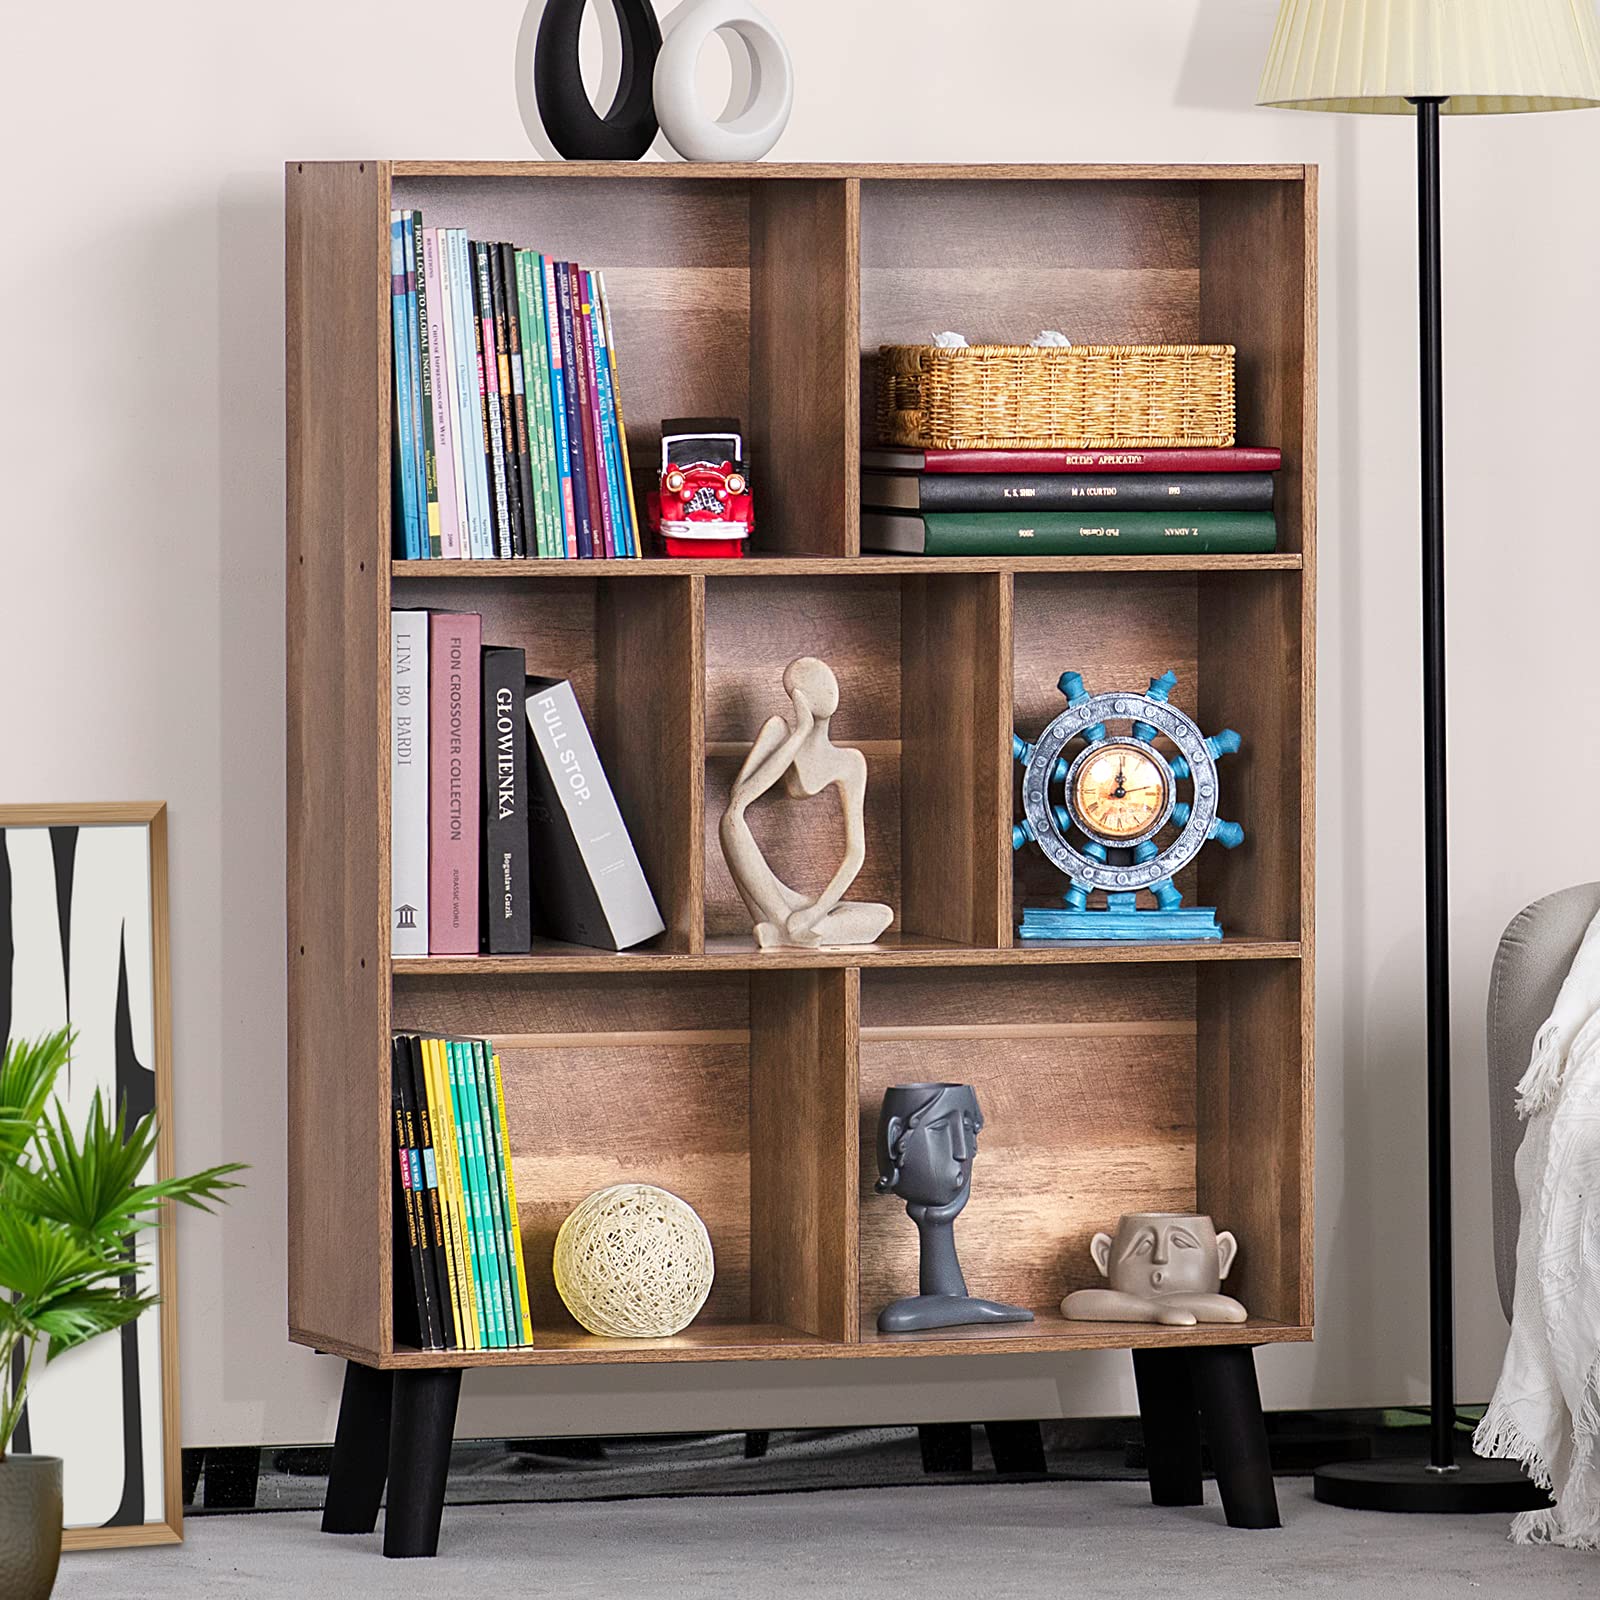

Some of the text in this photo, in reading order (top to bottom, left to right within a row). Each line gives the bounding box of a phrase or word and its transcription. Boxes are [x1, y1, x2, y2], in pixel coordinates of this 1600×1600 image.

[414, 225, 431, 396] FROM LOCAL TO GLOBAL ENGLISH
[526, 284, 535, 316] Englishes
[535, 287, 544, 319] Englishes
[545, 264, 560, 359] ENGLISH WORLD-WIDE
[474, 316, 479, 324] EA
[497, 316, 502, 324] EA
[511, 316, 515, 324] EA
[575, 316, 583, 342] Aberdeen
[591, 313, 599, 331] THE
[432, 324, 440, 353] CHINESE
[566, 334, 574, 365] Conference
[593, 334, 603, 373] JOURNAL
[577, 344, 585, 375] Conference
[434, 356, 443, 400] IMPRESSIONS
[598, 379, 605, 390] OF
[599, 395, 608, 416] ASIA
[602, 420, 610, 440] TEFL
[536, 491, 544, 522] Englishes
[1080, 488, 1085, 496] A
[1086, 488, 1117, 496] (CURTIN)
[1080, 528, 1119, 536] PhD (Curtin)
[1164, 528, 1198, 536] Z. ADNAN
[397, 634, 412, 766] LINA BO BARDI
[450, 638, 461, 840] FION CROSSOVER COLLECTION
[538, 697, 590, 806] FULL STOP.
[504, 894, 512, 918] Guzik
[396, 1110, 402, 1118] EA
[422, 1111, 427, 1119] EA
[406, 1112, 415, 1147] EA JOURNAL
[404, 1172, 409, 1181] NO
[414, 1174, 419, 1182] NO
[419, 1218, 427, 1249] AUSTRALIA
[434, 1215, 442, 1246] AUSTRALIA
[452, 1213, 460, 1244] review
[456, 1247, 464, 1280] studies
